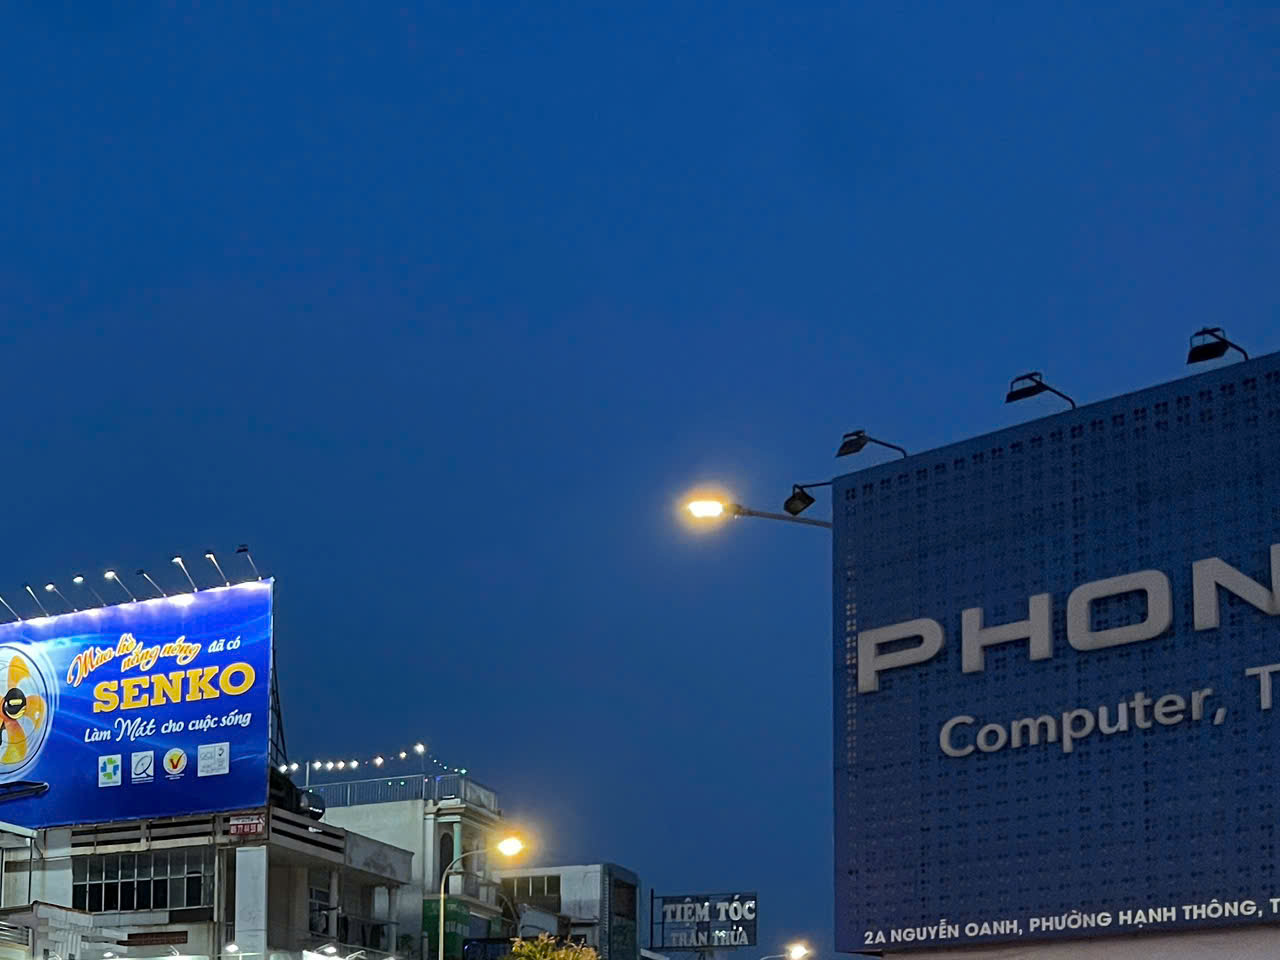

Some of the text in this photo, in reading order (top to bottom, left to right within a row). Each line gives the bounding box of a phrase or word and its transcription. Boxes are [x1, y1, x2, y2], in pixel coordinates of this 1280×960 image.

[208, 636, 241, 653] đã có
[93, 662, 256, 714] SENKO
[84, 709, 252, 742] Làm Mát cho cuộc sống
[939, 687, 1227, 758] Computer,
[716, 894, 756, 921] TÓC
[863, 929, 886, 945] 2A
[890, 918, 959, 943] NGUYỄN
[965, 918, 1023, 937] OANH,
[1029, 910, 1112, 932] PHƯỜNG
[1118, 906, 1177, 929] HẠNH
[1182, 897, 1263, 921] THÔNG,
